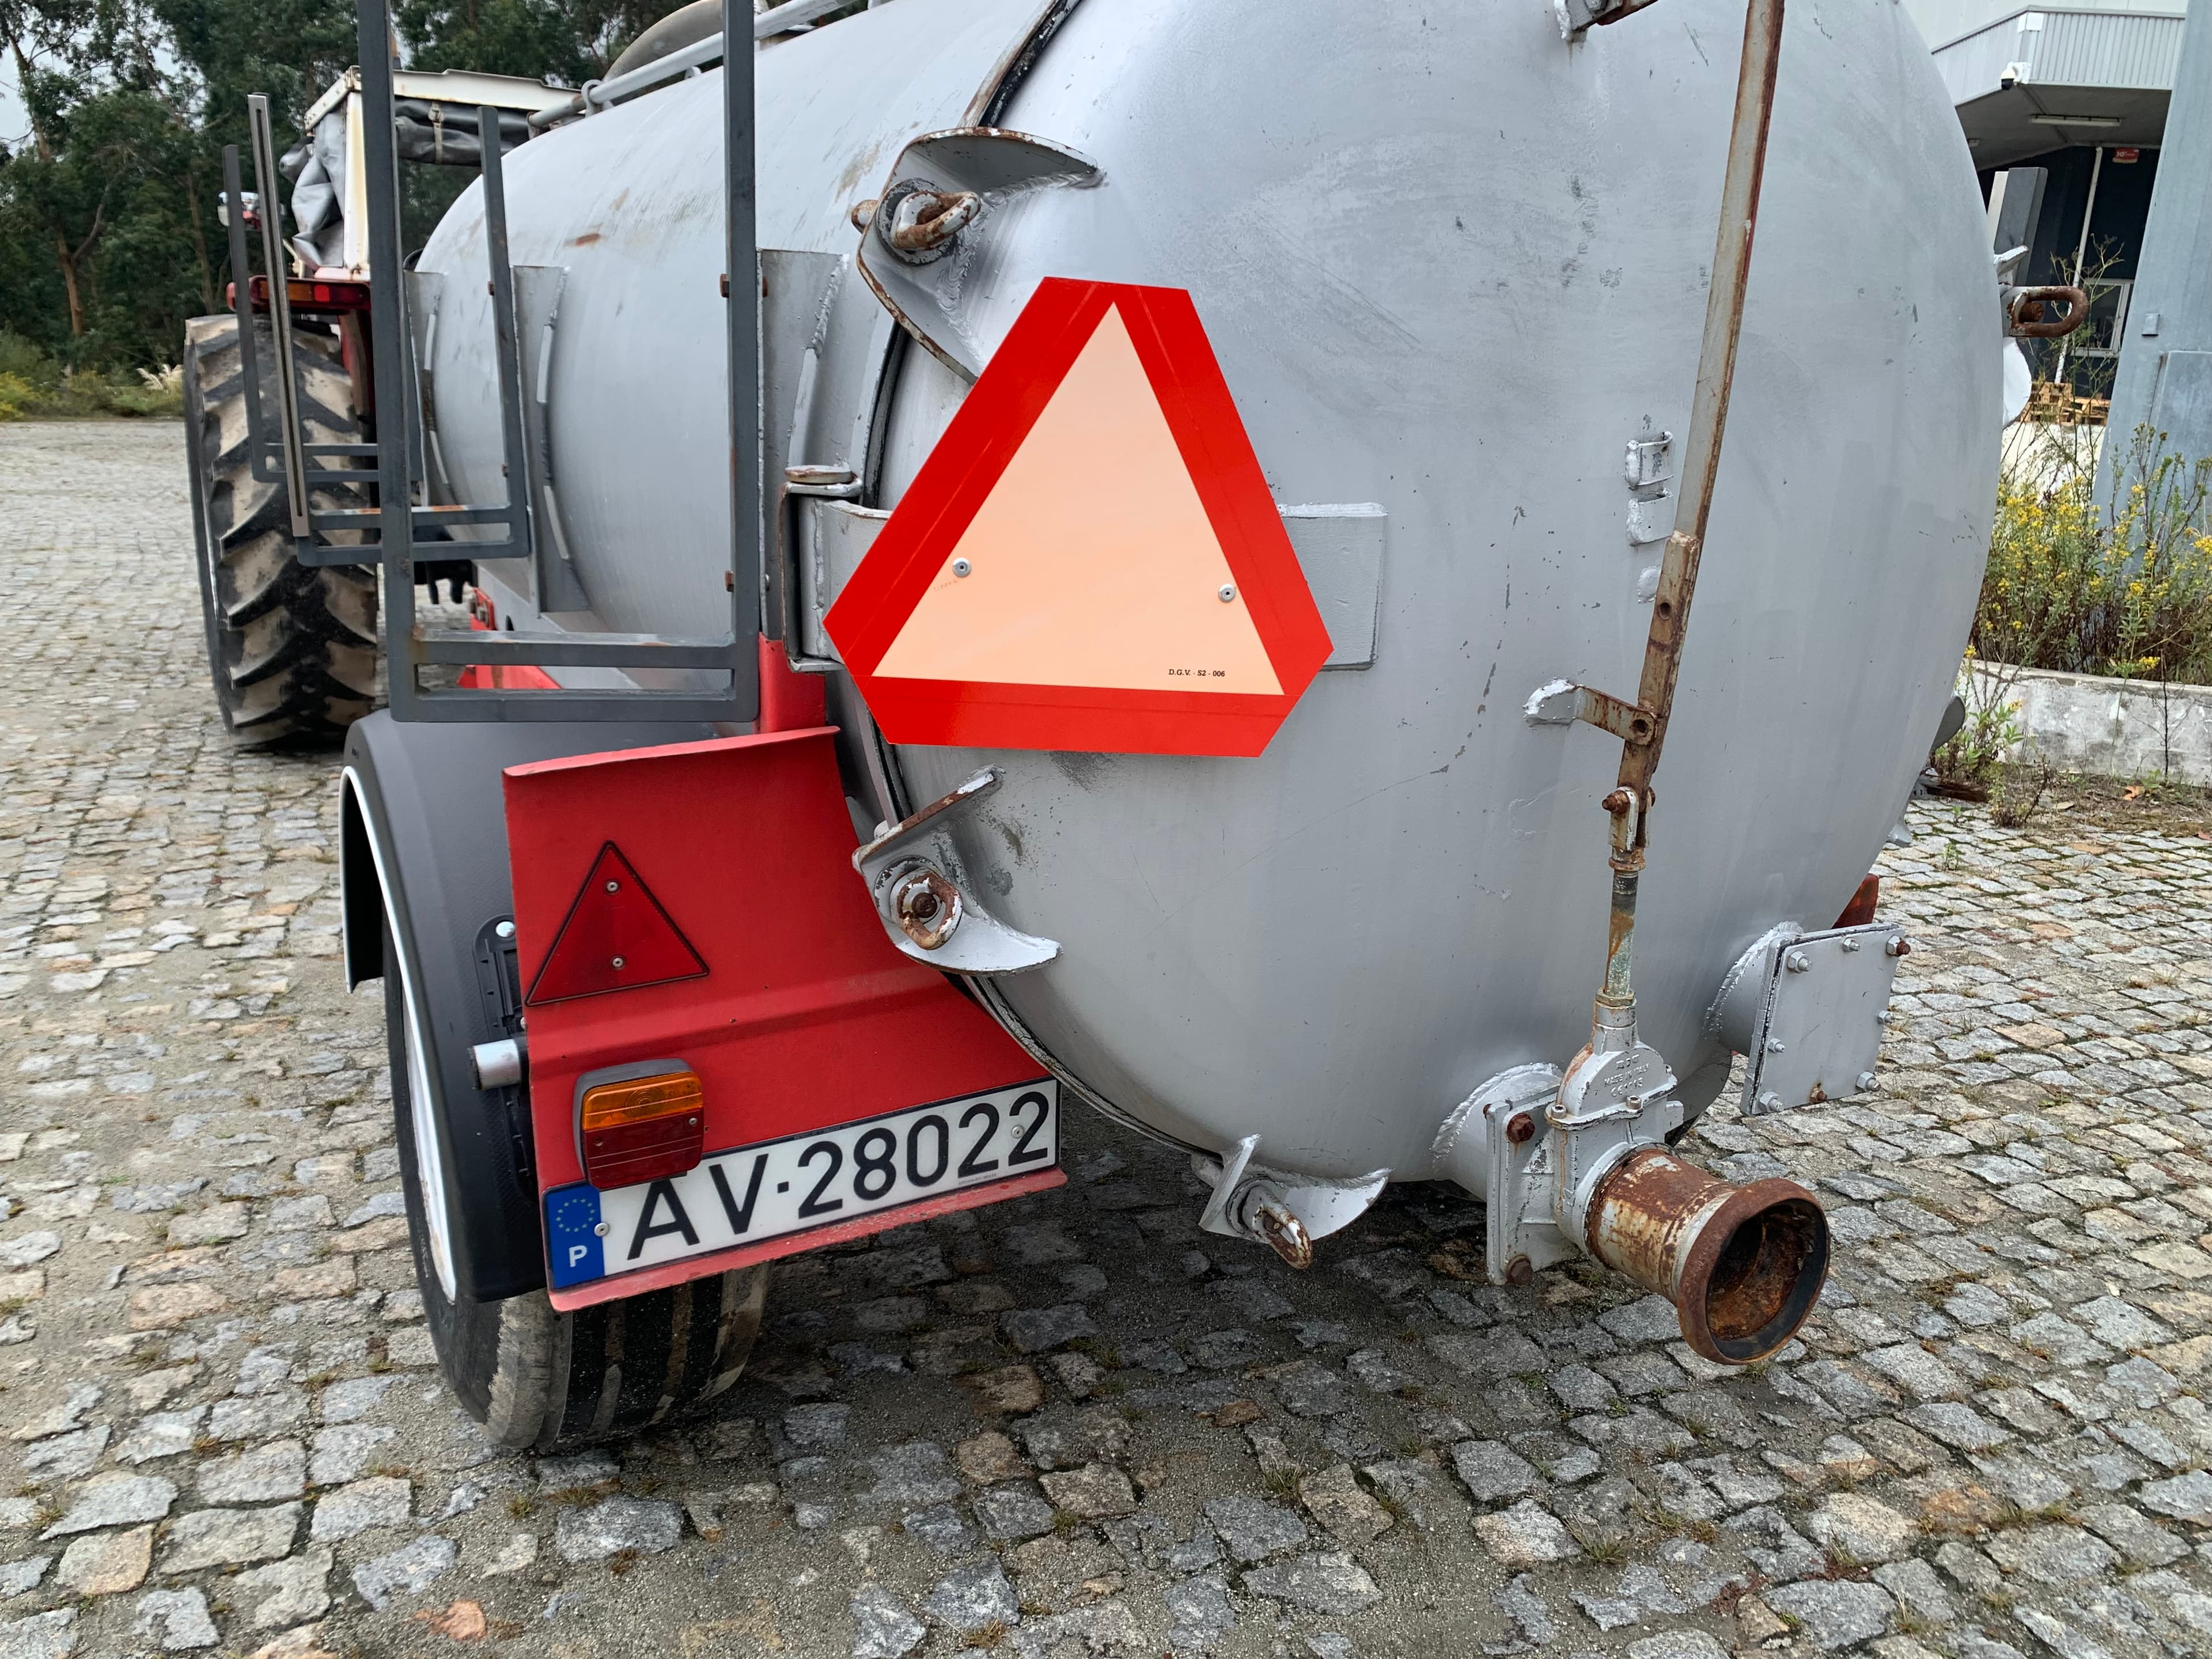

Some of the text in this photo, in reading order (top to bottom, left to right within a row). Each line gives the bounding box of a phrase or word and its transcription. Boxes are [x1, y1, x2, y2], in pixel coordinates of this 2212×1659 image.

[1603, 1063, 1649, 1087] MADE IN ITALY
[569, 1245, 588, 1267] P
